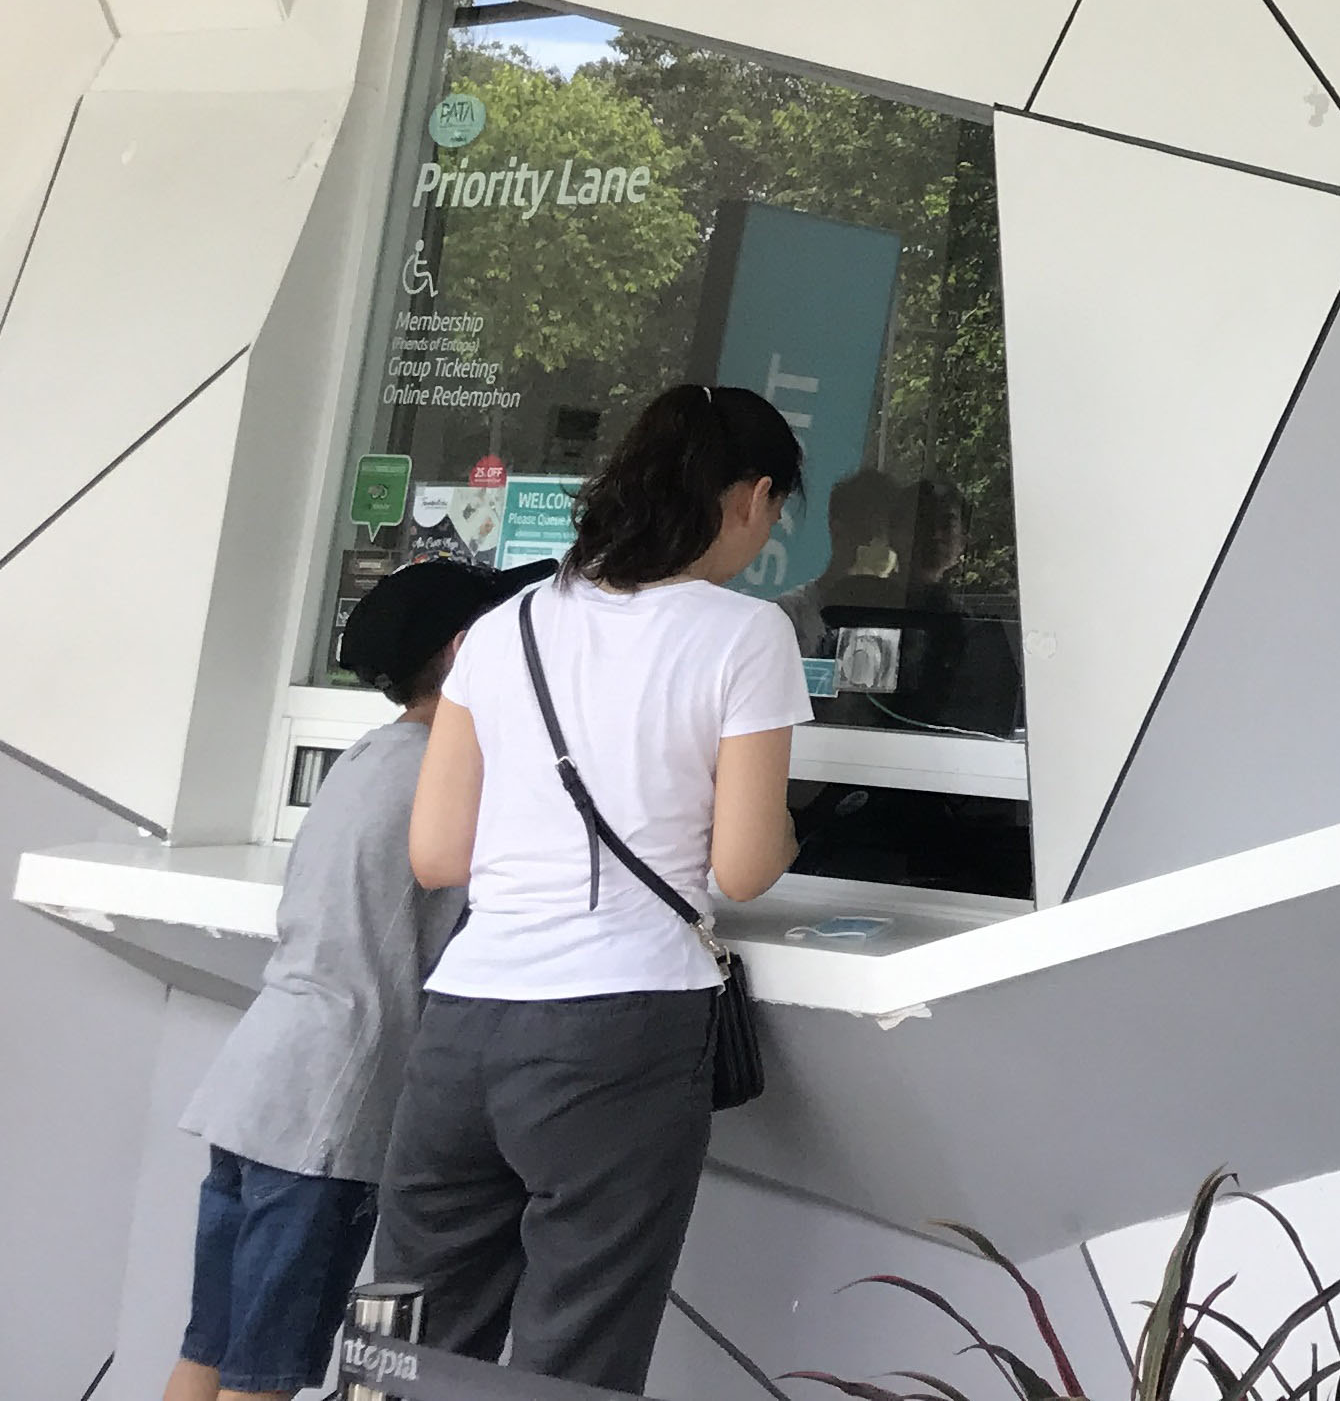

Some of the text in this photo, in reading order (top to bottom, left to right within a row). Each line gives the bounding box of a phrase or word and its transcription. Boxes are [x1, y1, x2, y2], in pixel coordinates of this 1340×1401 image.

[440, 101, 475, 123] PATA
[412, 156, 650, 220] Priority Lane
[395, 311, 484, 337] Membership
[430, 337, 442, 351] of
[388, 357, 499, 385] Group Ticketing
[383, 383, 521, 408] Online Redemption
[487, 466, 503, 478] OFF
[519, 492, 572, 510] WELCOM
[508, 512, 536, 525] Please
[538, 513, 566, 527] Queue
[344, 1337, 417, 1383] ntopia
